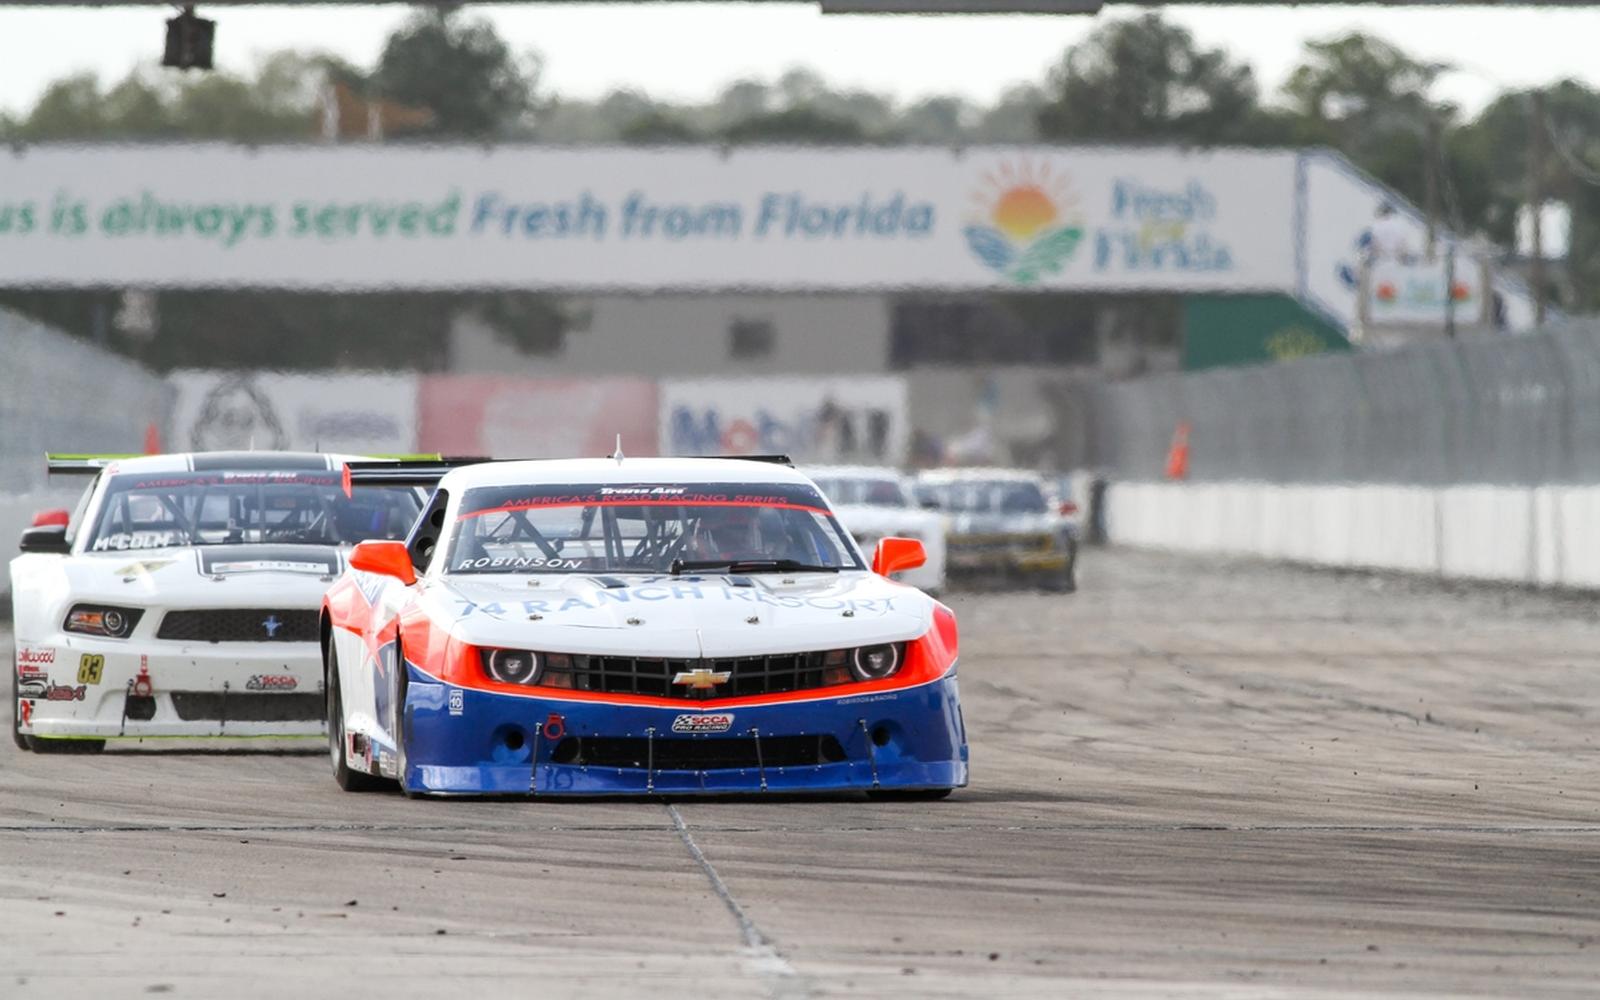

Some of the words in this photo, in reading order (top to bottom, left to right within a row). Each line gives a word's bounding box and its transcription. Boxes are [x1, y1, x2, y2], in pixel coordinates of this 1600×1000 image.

[50, 188, 88, 235] is
[99, 189, 277, 248] always
[292, 190, 459, 236] served
[470, 192, 608, 237] Fresh
[619, 192, 744, 238] from
[751, 191, 936, 238] Florida
[600, 487, 650, 495] Trans
[650, 487, 688, 495] Am
[502, 494, 597, 508] AMERICA'S
[602, 494, 651, 503] ROAD
[660, 494, 729, 503] RACING
[735, 494, 789, 504] SERIES
[458, 556, 583, 570] ROBINSON
[522, 585, 705, 614] RANCH
[720, 586, 898, 611] RESORT
[78, 653, 105, 685] 83
[691, 715, 729, 725] SCCA
